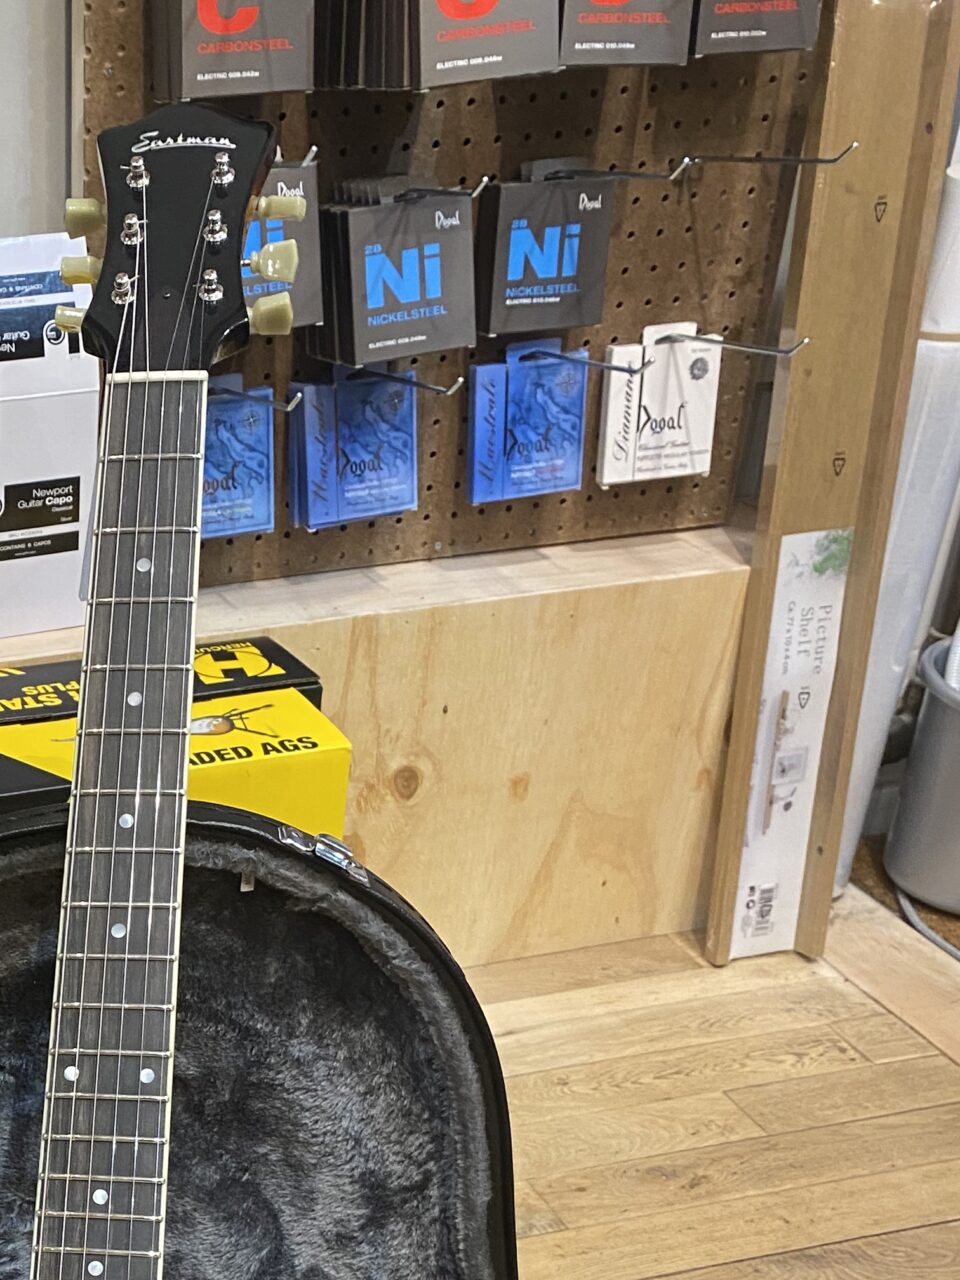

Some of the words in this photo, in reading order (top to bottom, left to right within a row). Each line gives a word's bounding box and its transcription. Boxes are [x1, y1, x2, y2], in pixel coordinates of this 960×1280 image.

[577, 12, 671, 25] CARBONSTEEL
[435, 19, 536, 42] CARBONSTEEL
[197, 39, 294, 54] CARBONSTEEL
[131, 130, 237, 153] Eastman
[507, 223, 581, 281] Ni
[365, 242, 442, 310] Ni
[243, 282, 293, 296] LSTEEL
[505, 283, 581, 298] NICKELSTEEL
[367, 304, 448, 326] NICKELSTEEL
[2, 330, 30, 341] Guitar
[203, 460, 244, 496] ogal
[32, 485, 73, 498] Newport
[17, 499, 44, 509] Guitar
[45, 495, 73, 506] Capo
[797, 605, 815, 658] Shelf
[811, 604, 833, 675] Picture
[196, 641, 253, 655] HERCU
[261, 736, 319, 756] AGS
